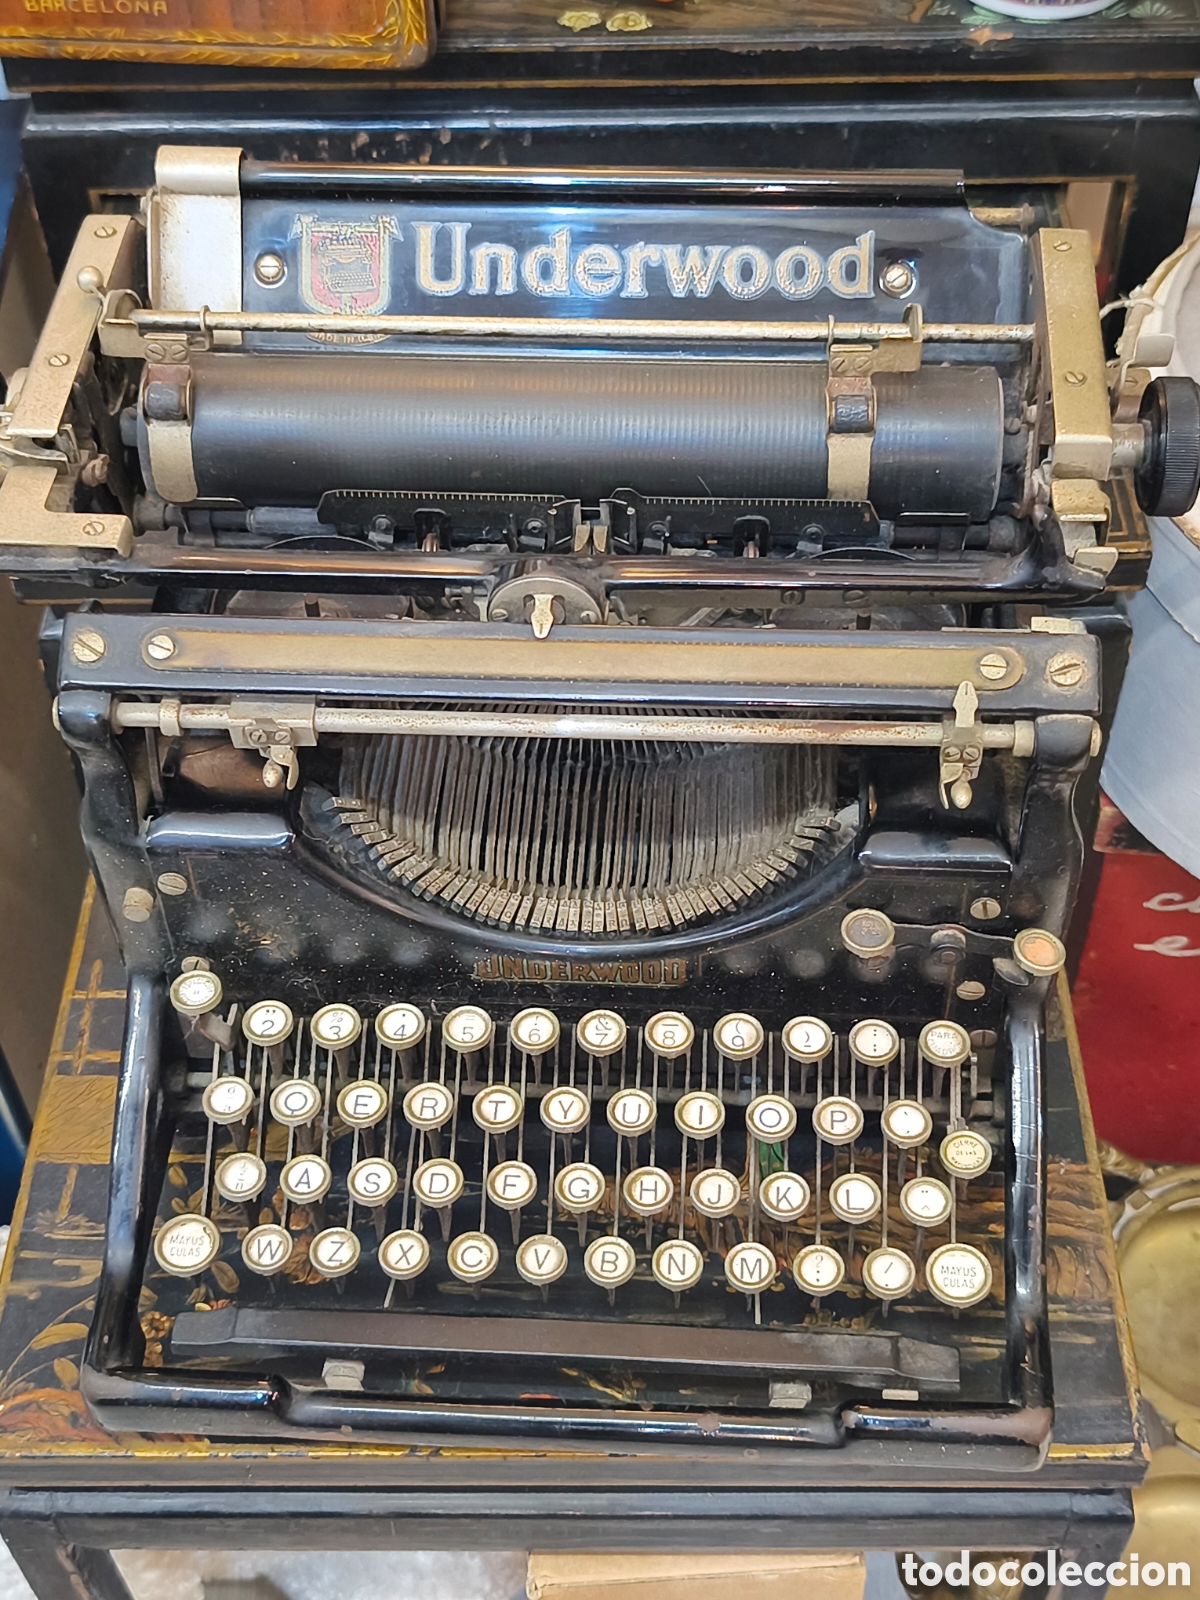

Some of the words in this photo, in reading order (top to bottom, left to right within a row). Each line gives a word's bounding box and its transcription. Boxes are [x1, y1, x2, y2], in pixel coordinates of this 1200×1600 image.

[25, 0, 168, 16] BARCELONA
[410, 221, 876, 299] Underwood
[260, 1019, 276, 1037] 2
[329, 1025, 343, 1040] 3
[393, 1024, 408, 1039] 4
[461, 1026, 475, 1043] 5
[528, 1028, 541, 1043] 6
[662, 1031, 676, 1046] 8
[595, 1033, 609, 1046] 7
[354, 1095, 373, 1115] E
[421, 1097, 438, 1117] R
[489, 1100, 506, 1120] T
[558, 1100, 574, 1119] Y
[622, 1103, 642, 1124] U
[759, 1107, 782, 1128] O
[830, 1110, 848, 1130] P
[294, 1168, 311, 1189] A
[364, 1172, 380, 1194] S
[429, 1173, 449, 1194] D
[502, 1174, 521, 1196] F
[568, 1177, 590, 1199] G
[639, 1180, 658, 1201] H
[707, 1184, 721, 1204] J
[776, 1186, 794, 1210] K
[846, 1189, 865, 1210] L
[170, 1246, 201, 1257] CULAS
[256, 1238, 282, 1262] W
[326, 1241, 346, 1263] Z
[394, 1243, 415, 1266] X
[461, 1245, 483, 1268] C
[534, 1248, 550, 1270] V
[600, 1251, 619, 1273] B
[668, 1253, 686, 1276] N
[740, 1257, 763, 1280] M
[940, 1265, 977, 1277] MAYUS
[943, 1277, 975, 1289] CULAS
